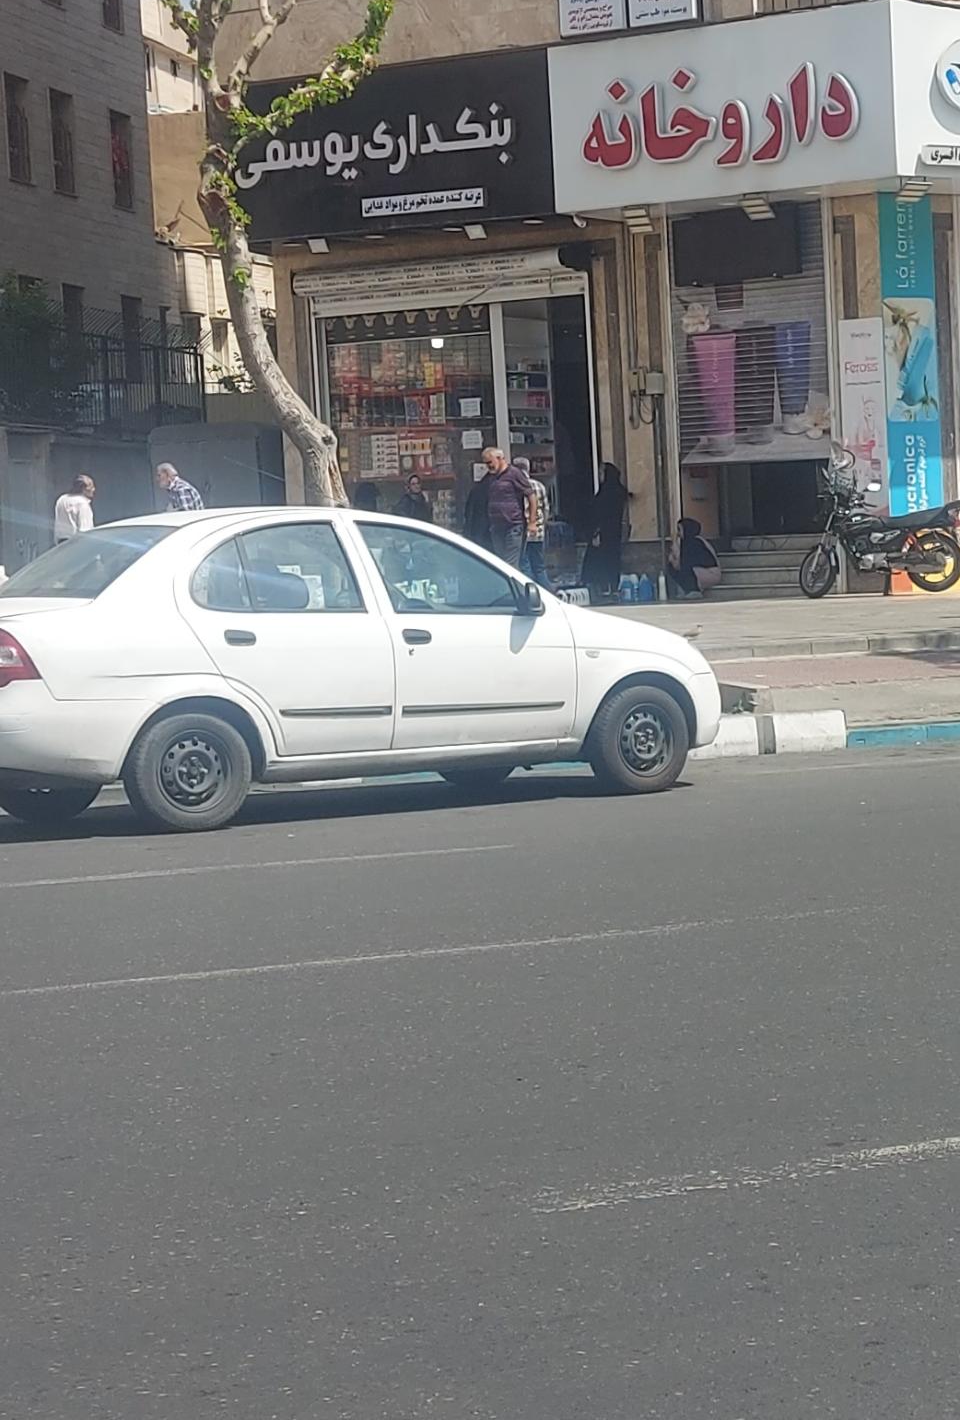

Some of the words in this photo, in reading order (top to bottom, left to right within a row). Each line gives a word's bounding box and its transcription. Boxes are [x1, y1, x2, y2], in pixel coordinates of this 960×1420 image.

[363, 102, 513, 174] بنکداری
[581, 61, 860, 170] داروخانه
[234, 126, 360, 189] یوسفی
[446, 191, 463, 203] کننده
[895, 202, 909, 259] farrer
